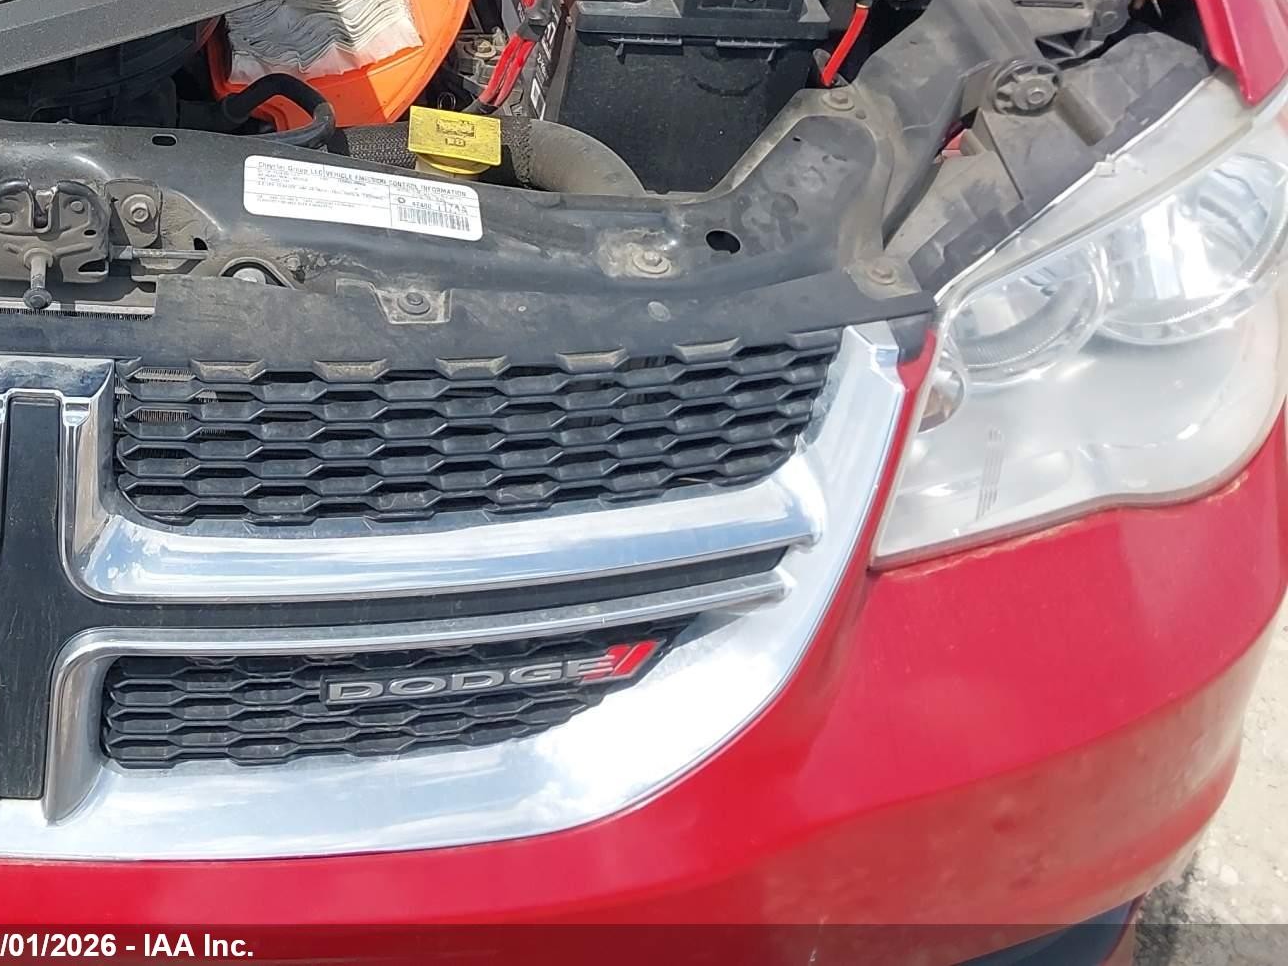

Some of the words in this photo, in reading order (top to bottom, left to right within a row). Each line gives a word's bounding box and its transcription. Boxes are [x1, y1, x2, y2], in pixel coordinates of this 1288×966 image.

[287, 165, 309, 176] Group
[325, 171, 353, 181] VEHICLE
[420, 184, 467, 198] INFORMATION
[328, 654, 614, 702] DODGE
